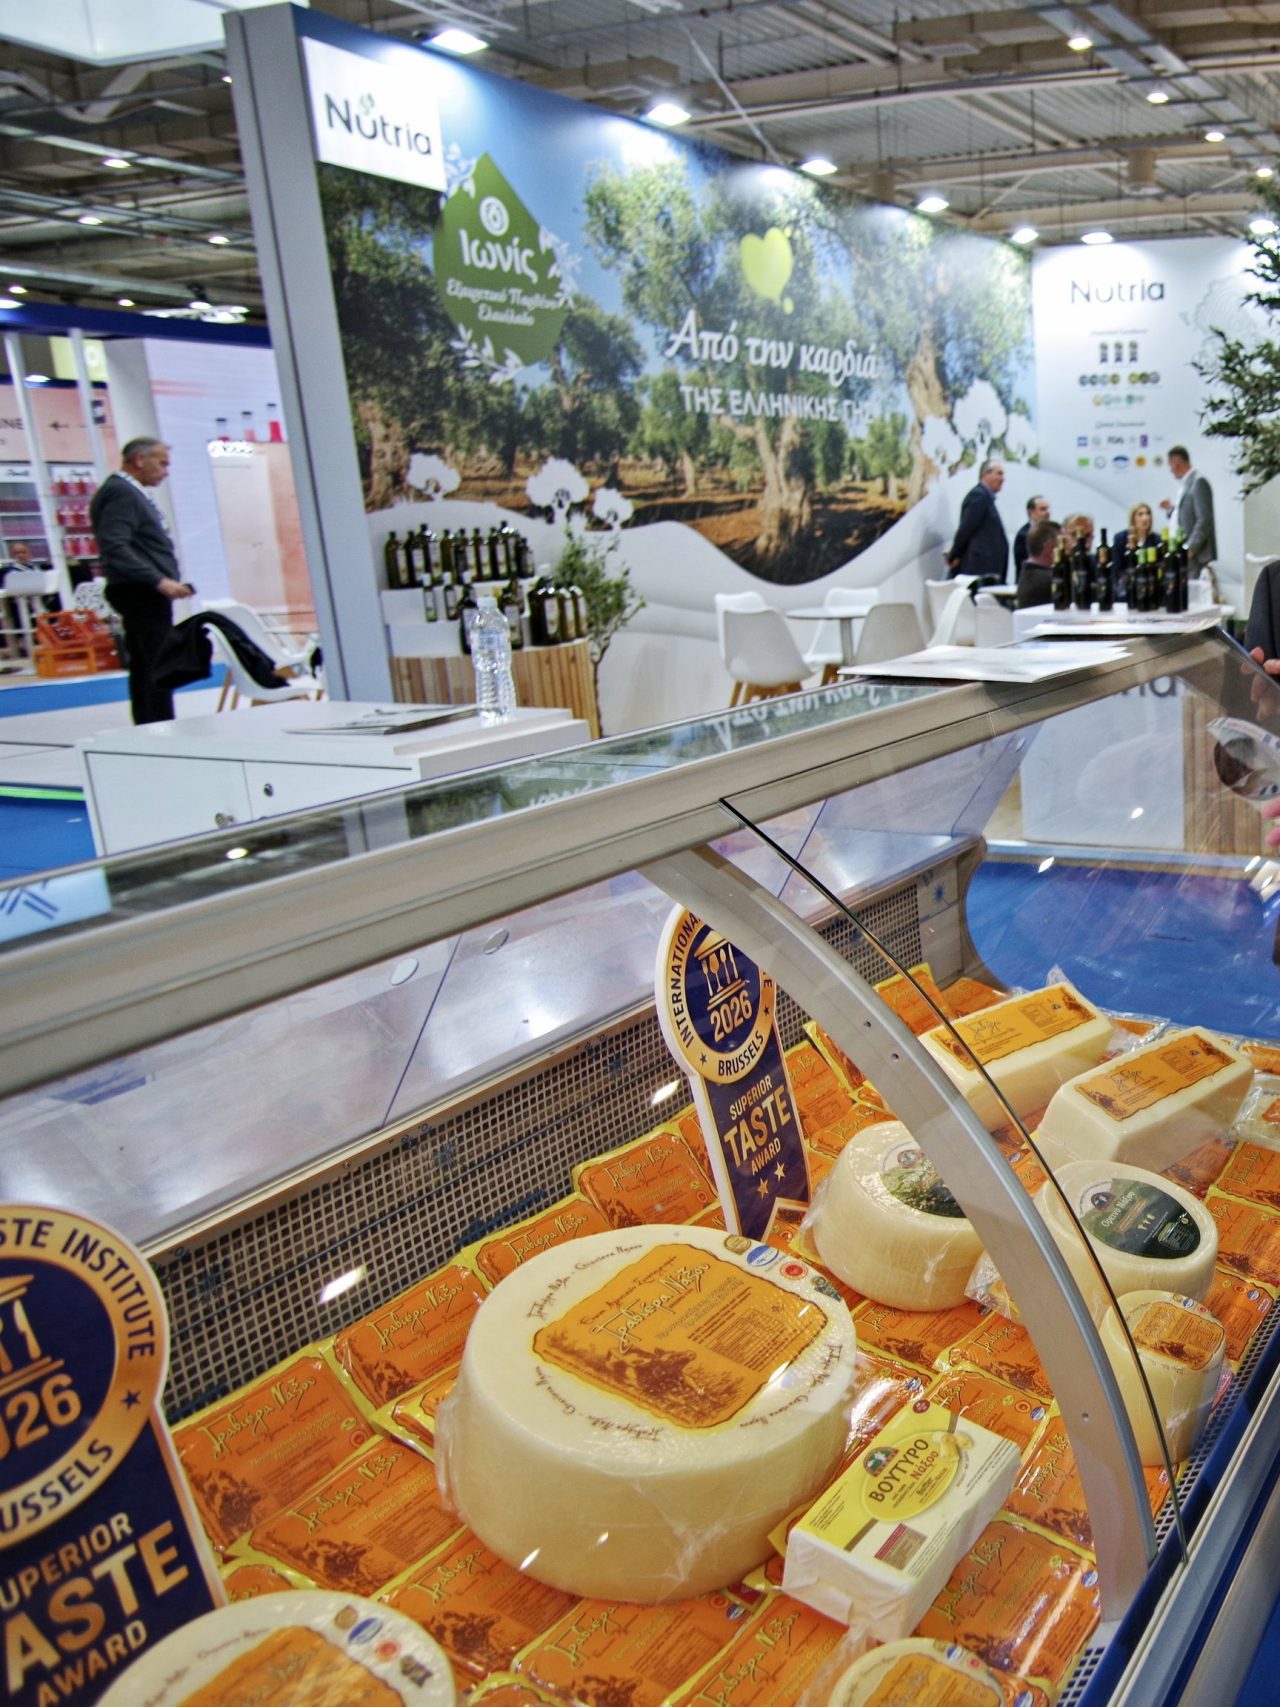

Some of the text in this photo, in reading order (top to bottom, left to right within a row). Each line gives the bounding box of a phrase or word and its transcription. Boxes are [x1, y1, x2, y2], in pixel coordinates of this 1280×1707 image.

[325, 93, 432, 155] Nutria
[459, 228, 538, 284] Ιωνίς
[1071, 279, 1164, 304] Nutria
[665, 309, 881, 387] Από την καρδιά
[680, 385, 725, 415] ΤΗΣ
[729, 389, 840, 421] ΕΛΛΗΝΙΚΗΣ
[671, 912, 701, 1048] INTERNATIONA
[710, 990, 753, 1042] 2026
[718, 1030, 764, 1077] BRUSSELS
[729, 1075, 773, 1121] SUPERIOR
[724, 1085, 791, 1168] TASTE
[751, 1137, 781, 1176] AWARD
[61, 1228, 155, 1360] INSTITUTE
[590, 1295, 674, 1354] Γραβιέρα
[659, 1264, 711, 1294] Νάξου
[271, 1376, 317, 1411] Νάξου
[868, 1438, 929, 1503] ΒΟΥΤΥΡΟ
[910, 1450, 940, 1481] Νάξου
[38, 1620, 147, 1707] AWARD
